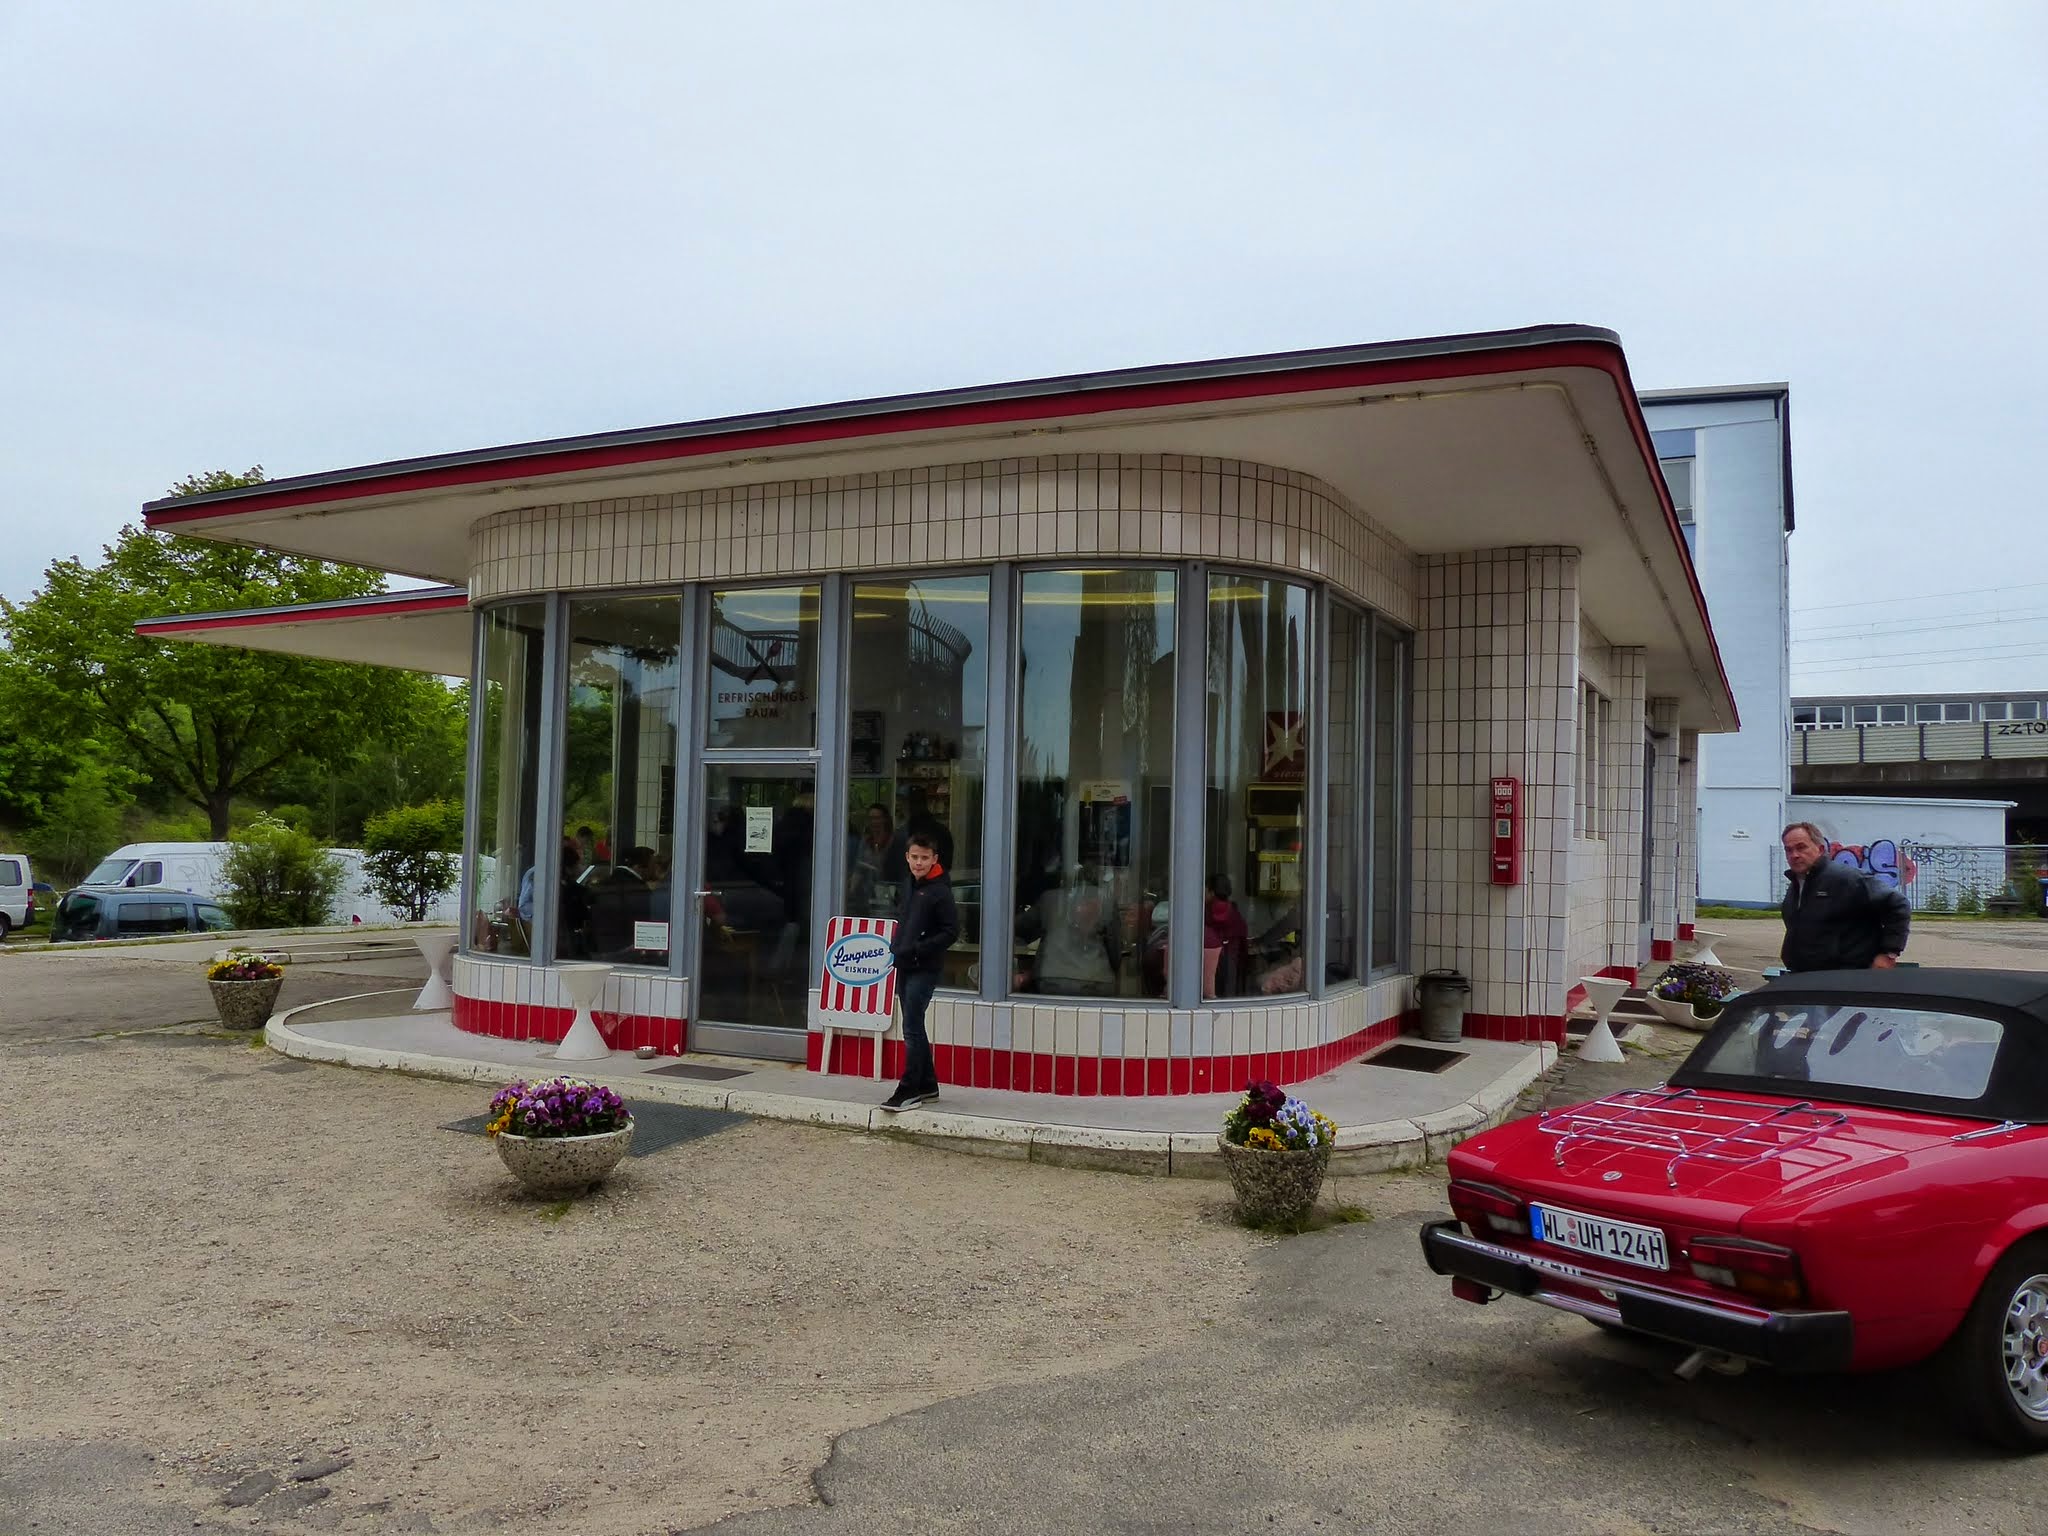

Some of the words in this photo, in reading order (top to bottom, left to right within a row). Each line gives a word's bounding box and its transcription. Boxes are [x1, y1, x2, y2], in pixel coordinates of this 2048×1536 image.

[718, 691, 808, 703] ERFRISCHUNGS-
[745, 707, 779, 718] RAUM
[833, 945, 885, 967] Langnese
[845, 966, 880, 975] EISKREM
[1577, 1220, 1604, 1251] UH
[1608, 1228, 1664, 1265] 124H
